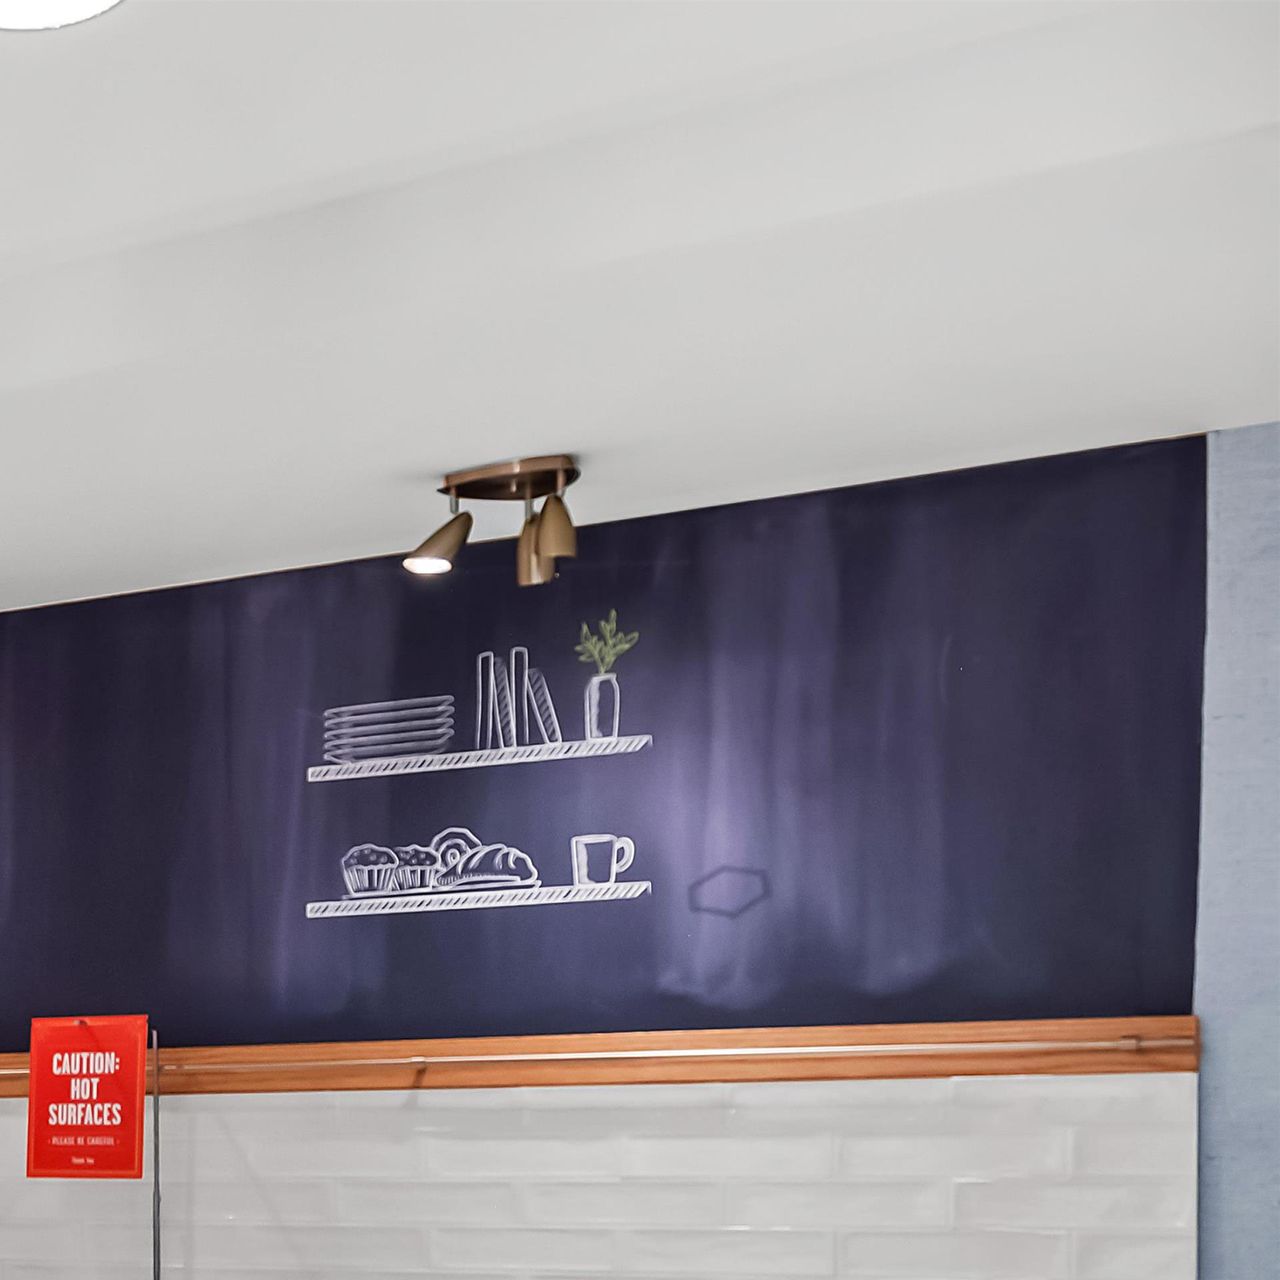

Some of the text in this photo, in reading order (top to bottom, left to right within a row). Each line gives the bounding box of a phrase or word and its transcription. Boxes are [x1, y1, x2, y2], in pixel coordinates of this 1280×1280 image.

[52, 1051, 120, 1075] CAUTION:
[71, 1078, 100, 1100] HOT
[48, 1103, 122, 1126] SURFACES
